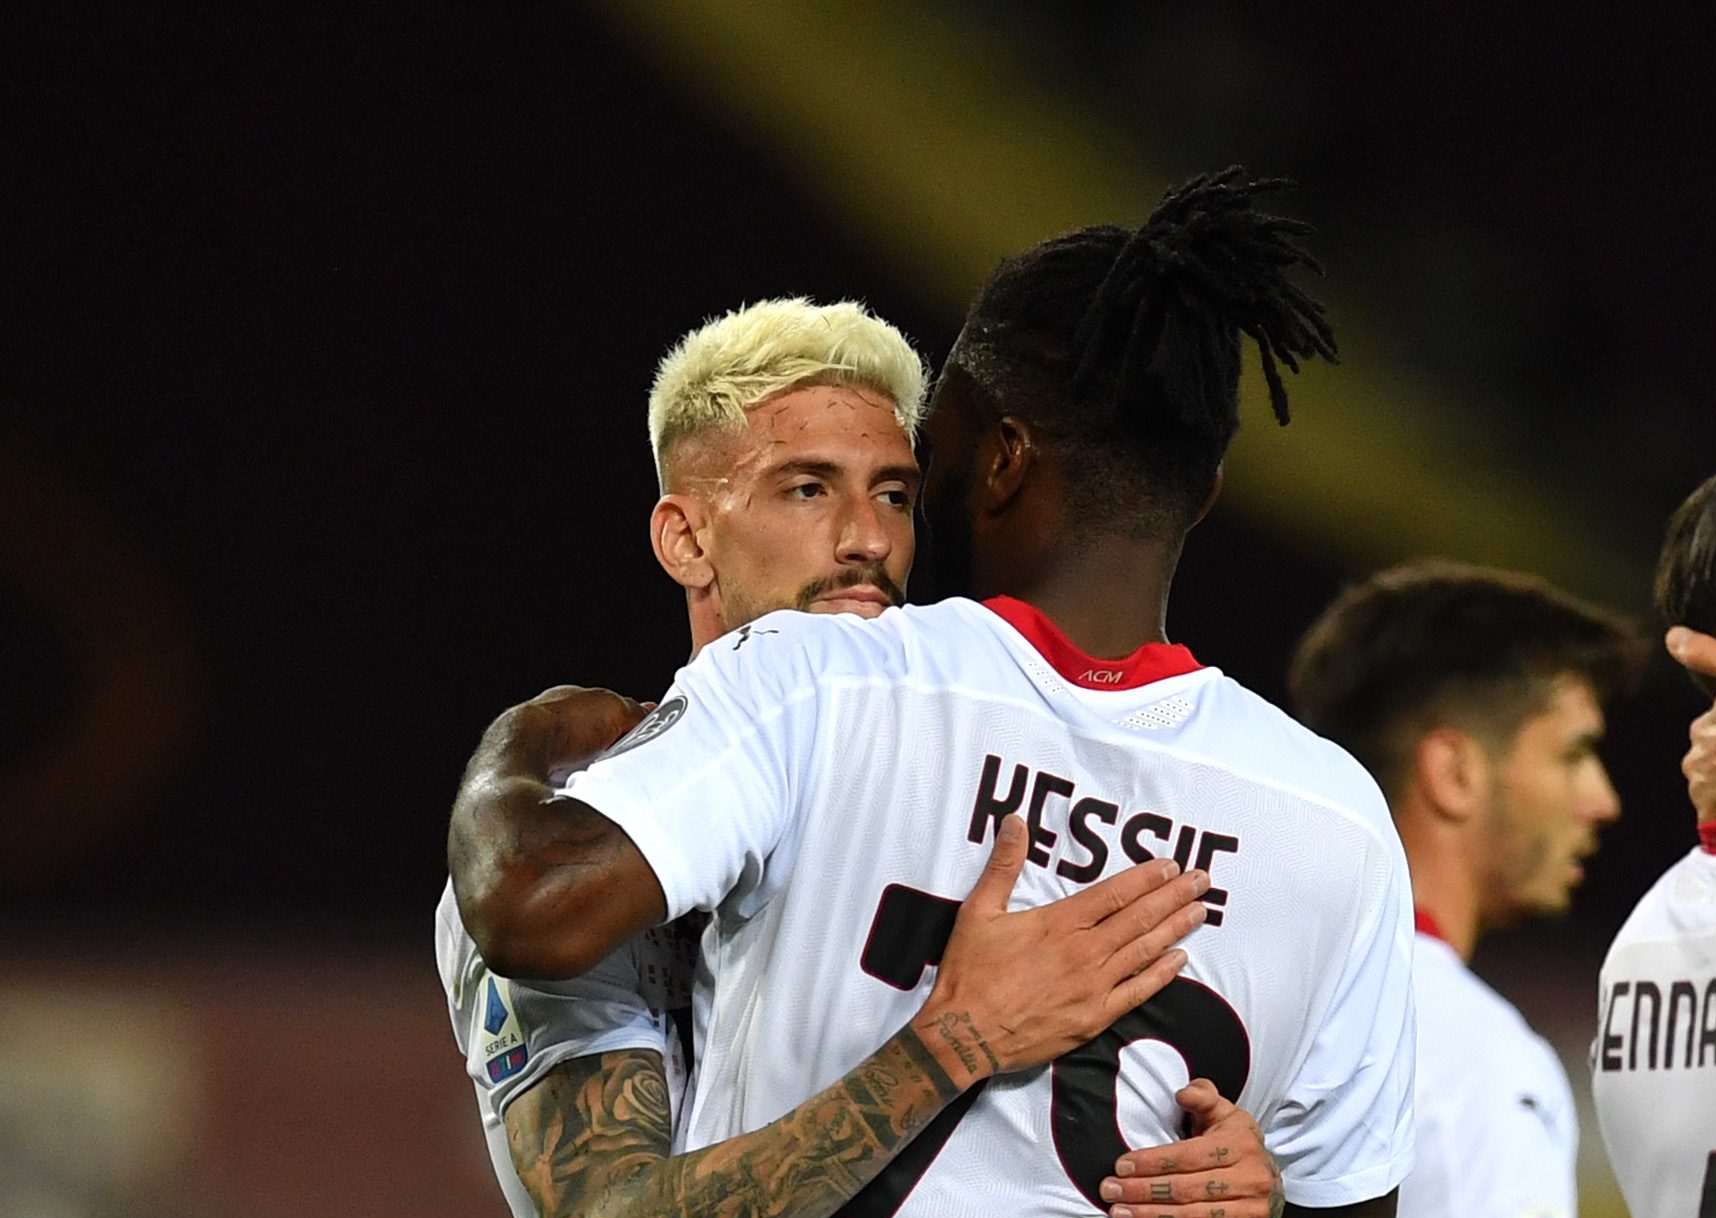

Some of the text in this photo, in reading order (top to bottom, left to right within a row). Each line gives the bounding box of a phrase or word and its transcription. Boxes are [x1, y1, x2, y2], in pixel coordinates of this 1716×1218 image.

[1078, 669, 1124, 684] ACM
[967, 754, 1239, 927] KESSIE
[485, 1033, 518, 1057] SERIE A
